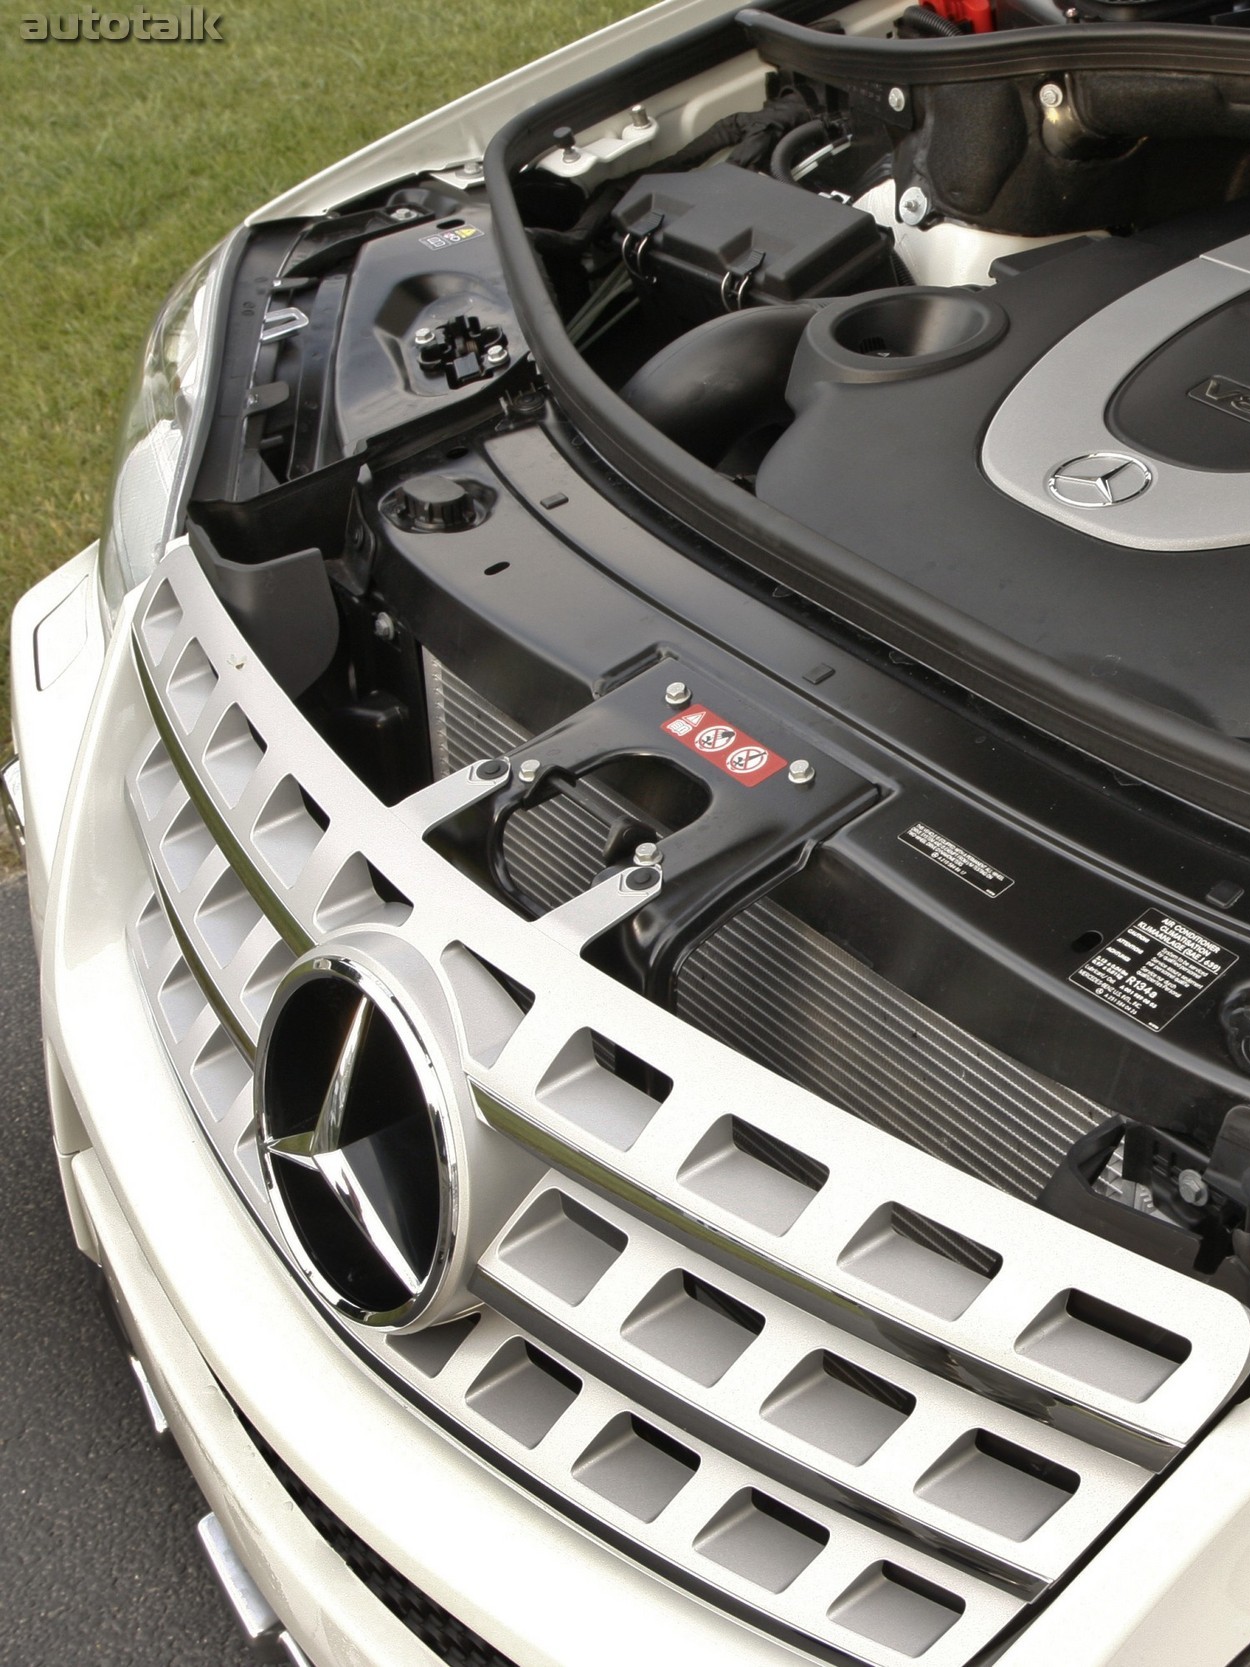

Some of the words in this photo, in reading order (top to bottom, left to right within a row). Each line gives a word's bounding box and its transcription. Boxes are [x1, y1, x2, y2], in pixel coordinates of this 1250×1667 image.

[1137, 922, 1186, 951] KLIMAANLAGE
[1159, 925, 1211, 957] CLIMATISATION
[1173, 925, 1221, 953] CONDITIONER
[1078, 970, 1115, 993] MERCEDES-BENZ
[1125, 976, 1161, 999] R134a
